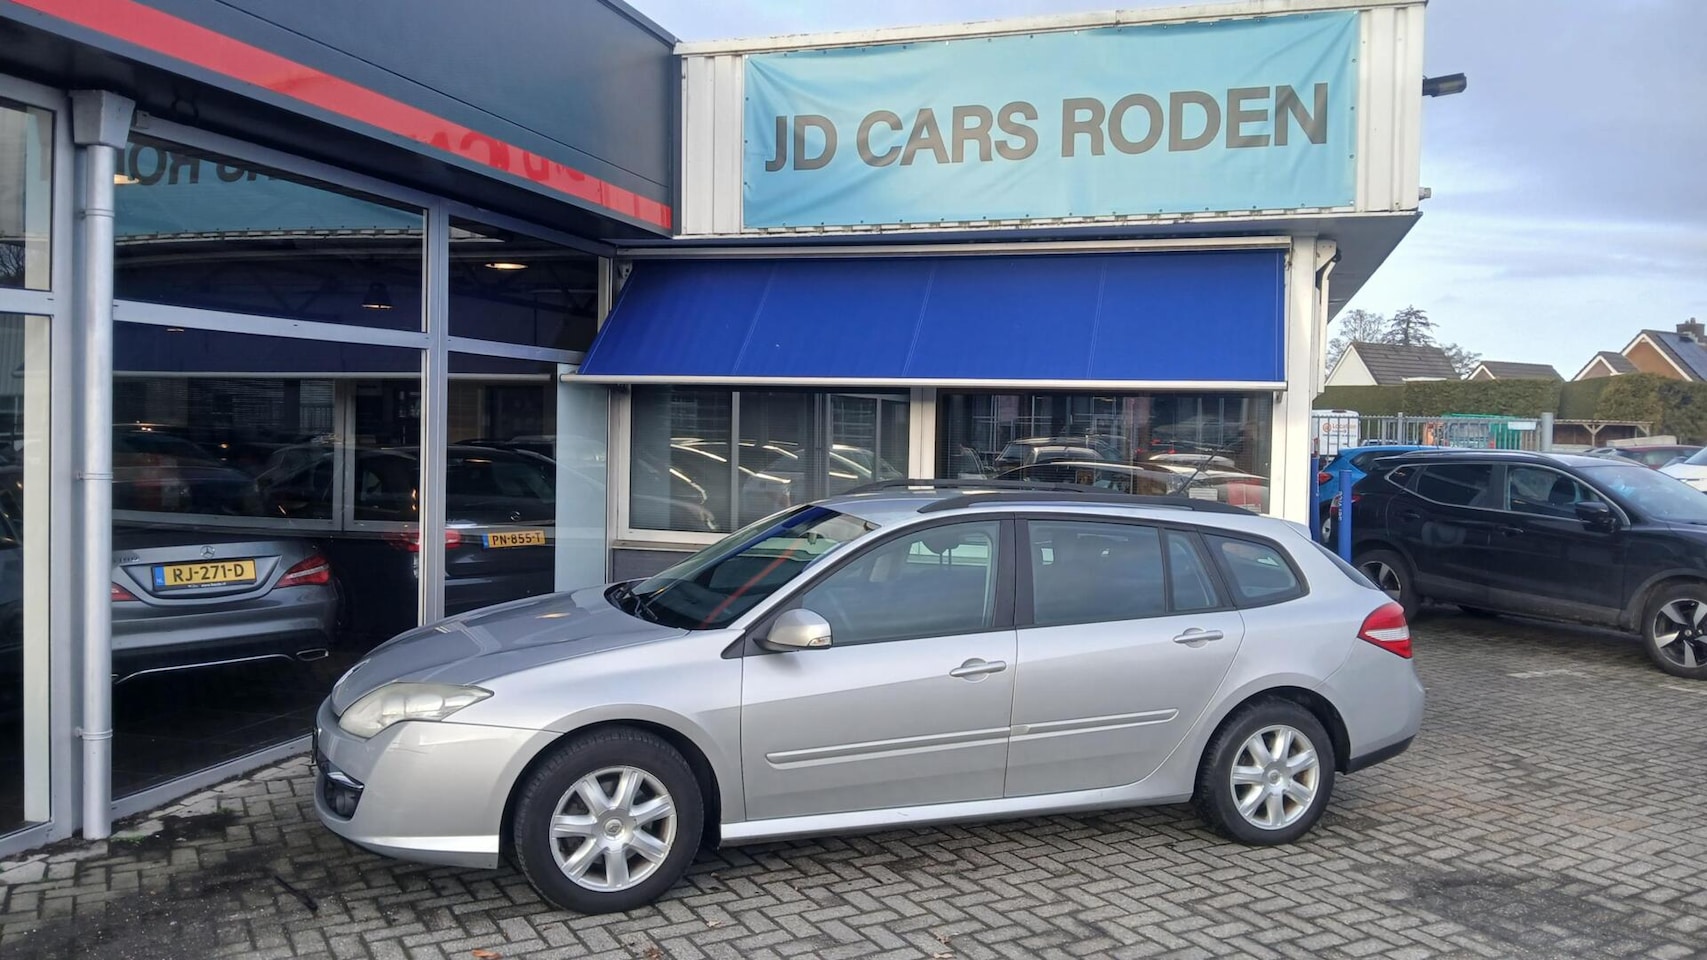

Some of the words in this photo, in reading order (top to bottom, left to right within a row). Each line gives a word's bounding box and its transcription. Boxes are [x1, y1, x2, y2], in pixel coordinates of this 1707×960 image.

[765, 115, 838, 171] JD
[856, 101, 1039, 167] CARS
[1061, 82, 1329, 158] RODEN
[492, 532, 541, 546] PN-855-T
[173, 563, 244, 583] RJ-271-D
